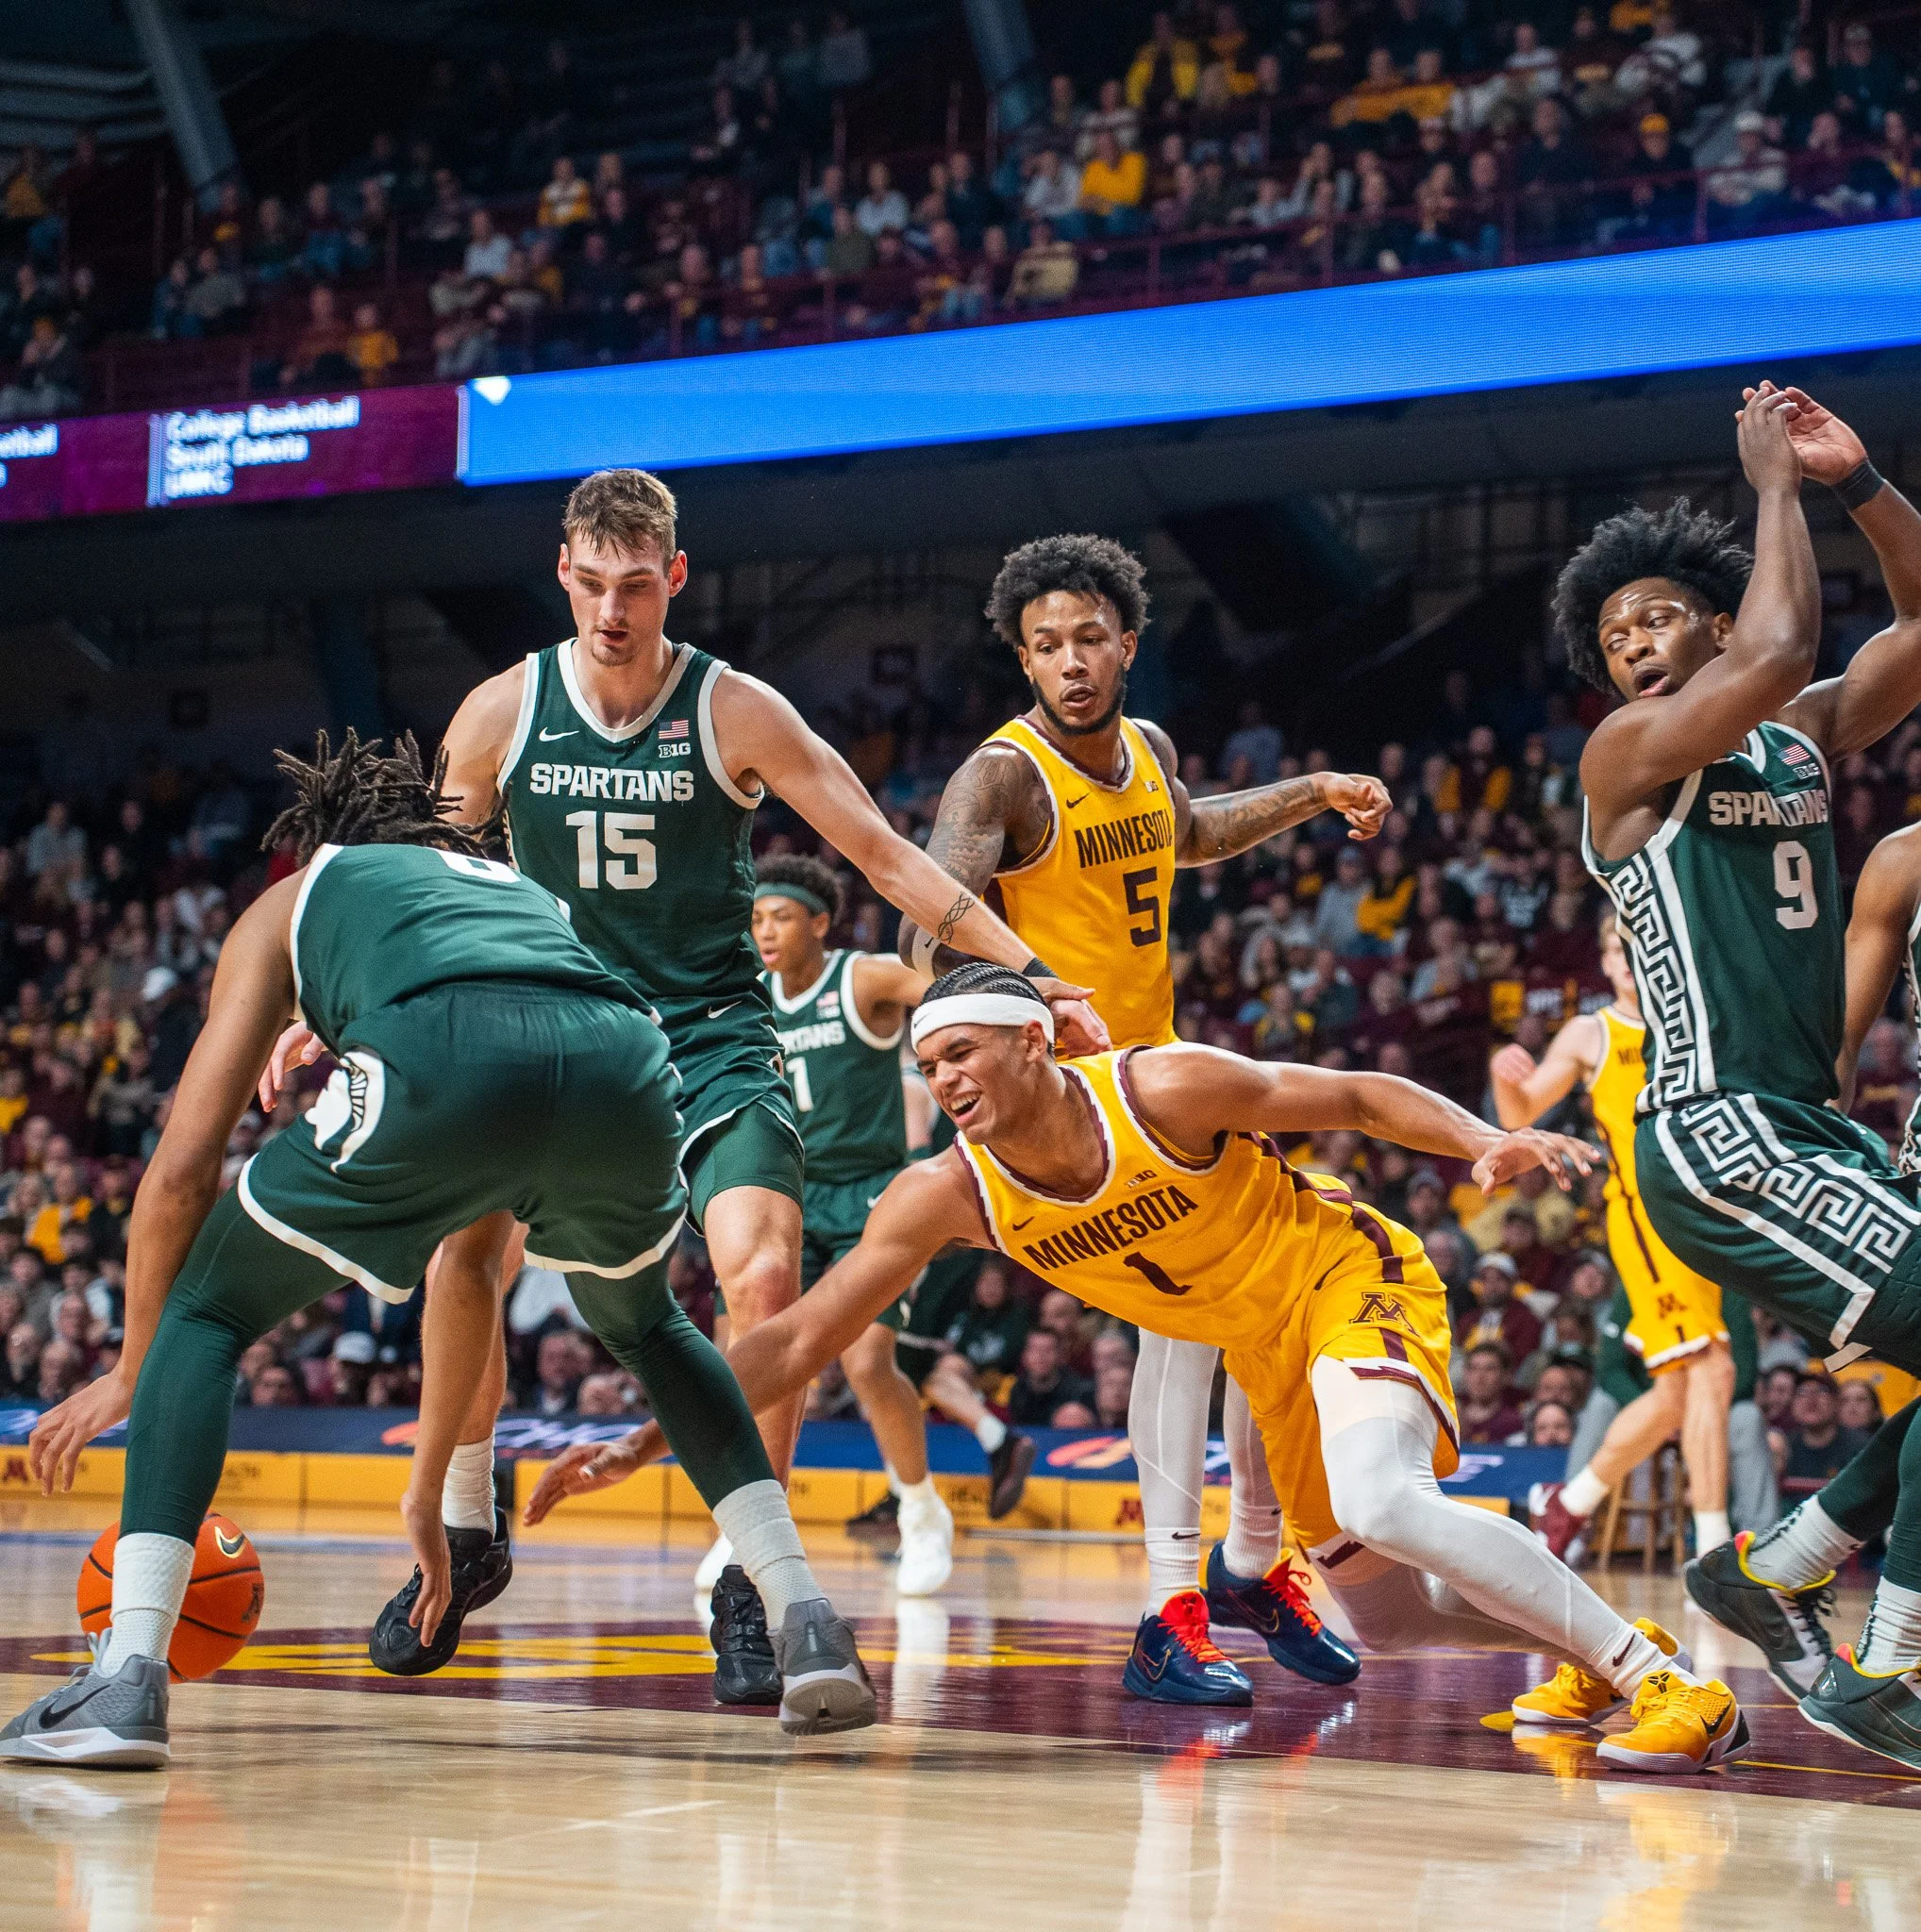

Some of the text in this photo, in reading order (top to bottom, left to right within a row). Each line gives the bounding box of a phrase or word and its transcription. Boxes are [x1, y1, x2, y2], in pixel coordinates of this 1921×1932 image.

[166, 395, 360, 451] College Basketball
[165, 434, 309, 474] South Dakota
[529, 762, 694, 802] SPARTANS
[565, 810, 658, 890] 15
[1074, 808, 1173, 869] MINNESOTA
[1122, 865, 1162, 948] 5
[1772, 840, 1819, 930] 9
[785, 1057, 814, 1112] 1
[1021, 1185, 1199, 1271] MINNESOTA
[1122, 1251, 1194, 1296] 1
